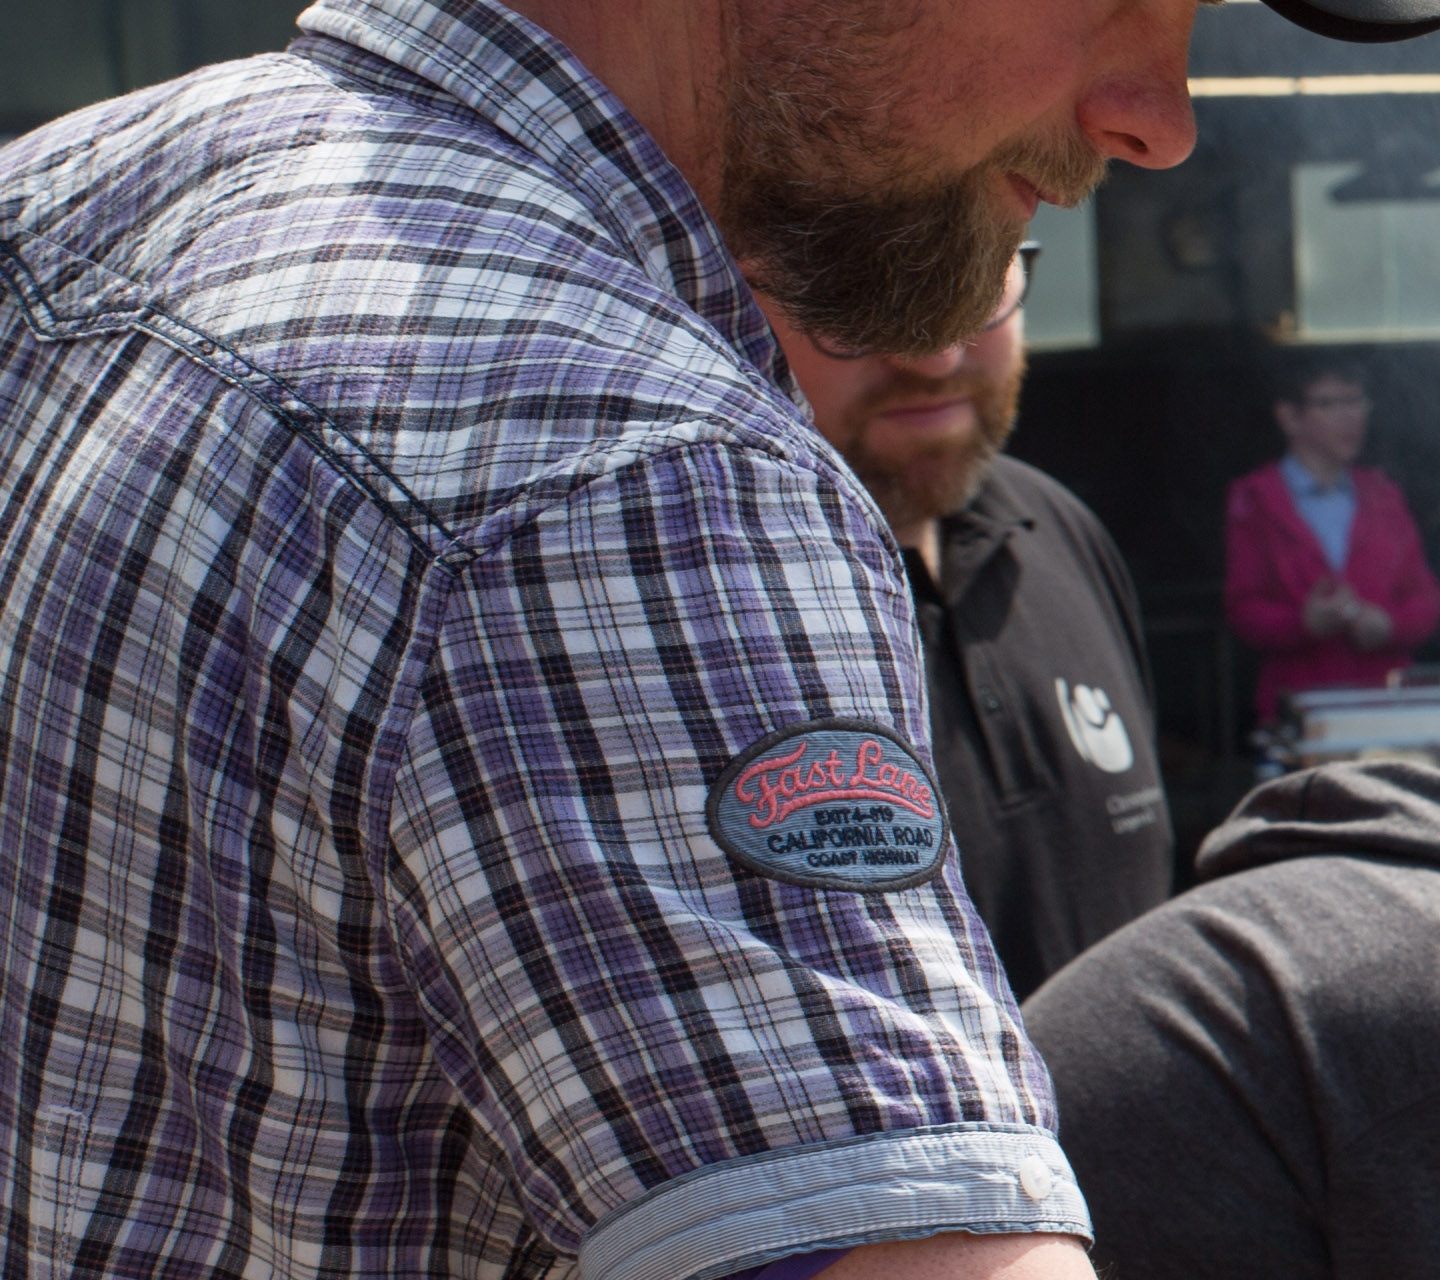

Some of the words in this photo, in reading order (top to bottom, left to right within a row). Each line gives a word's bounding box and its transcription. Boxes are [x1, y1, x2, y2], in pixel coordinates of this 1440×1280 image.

[736, 741, 844, 828] Fast
[849, 740, 932, 812] Lane
[814, 808, 851, 826] EXIT
[767, 826, 888, 854] CALIFORNIA
[893, 826, 934, 848] ROAD
[807, 850, 858, 867] COAST
